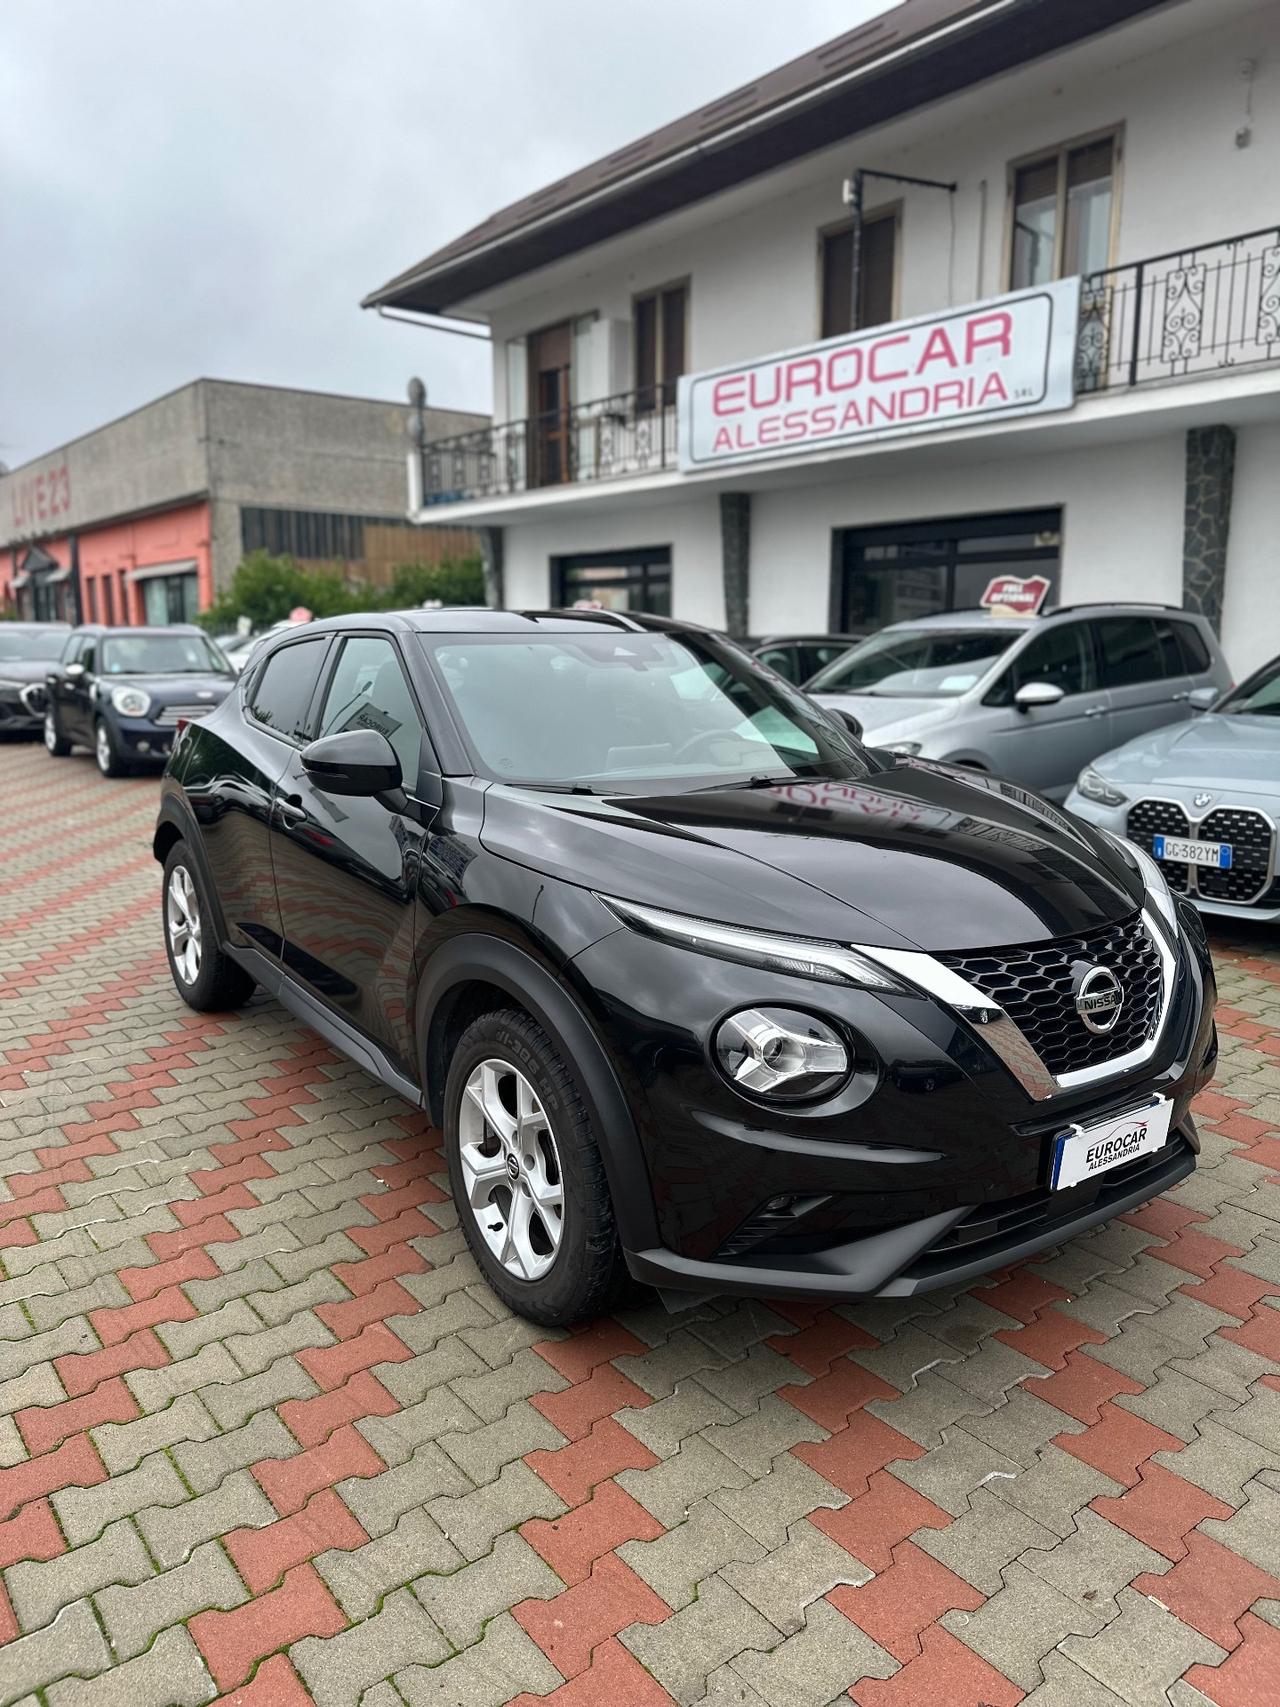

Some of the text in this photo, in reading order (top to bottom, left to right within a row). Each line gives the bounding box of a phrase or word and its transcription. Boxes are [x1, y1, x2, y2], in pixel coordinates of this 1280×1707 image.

[713, 311, 1012, 416] EUROCAR
[713, 371, 1008, 453] ALESSANDRIA
[1084, 990, 1120, 1011] NISSA
[540, 1077, 560, 1110] HP
[1086, 1127, 1147, 1164] EUROCAR
[1088, 1143, 1140, 1172] ALESSANDRIA
